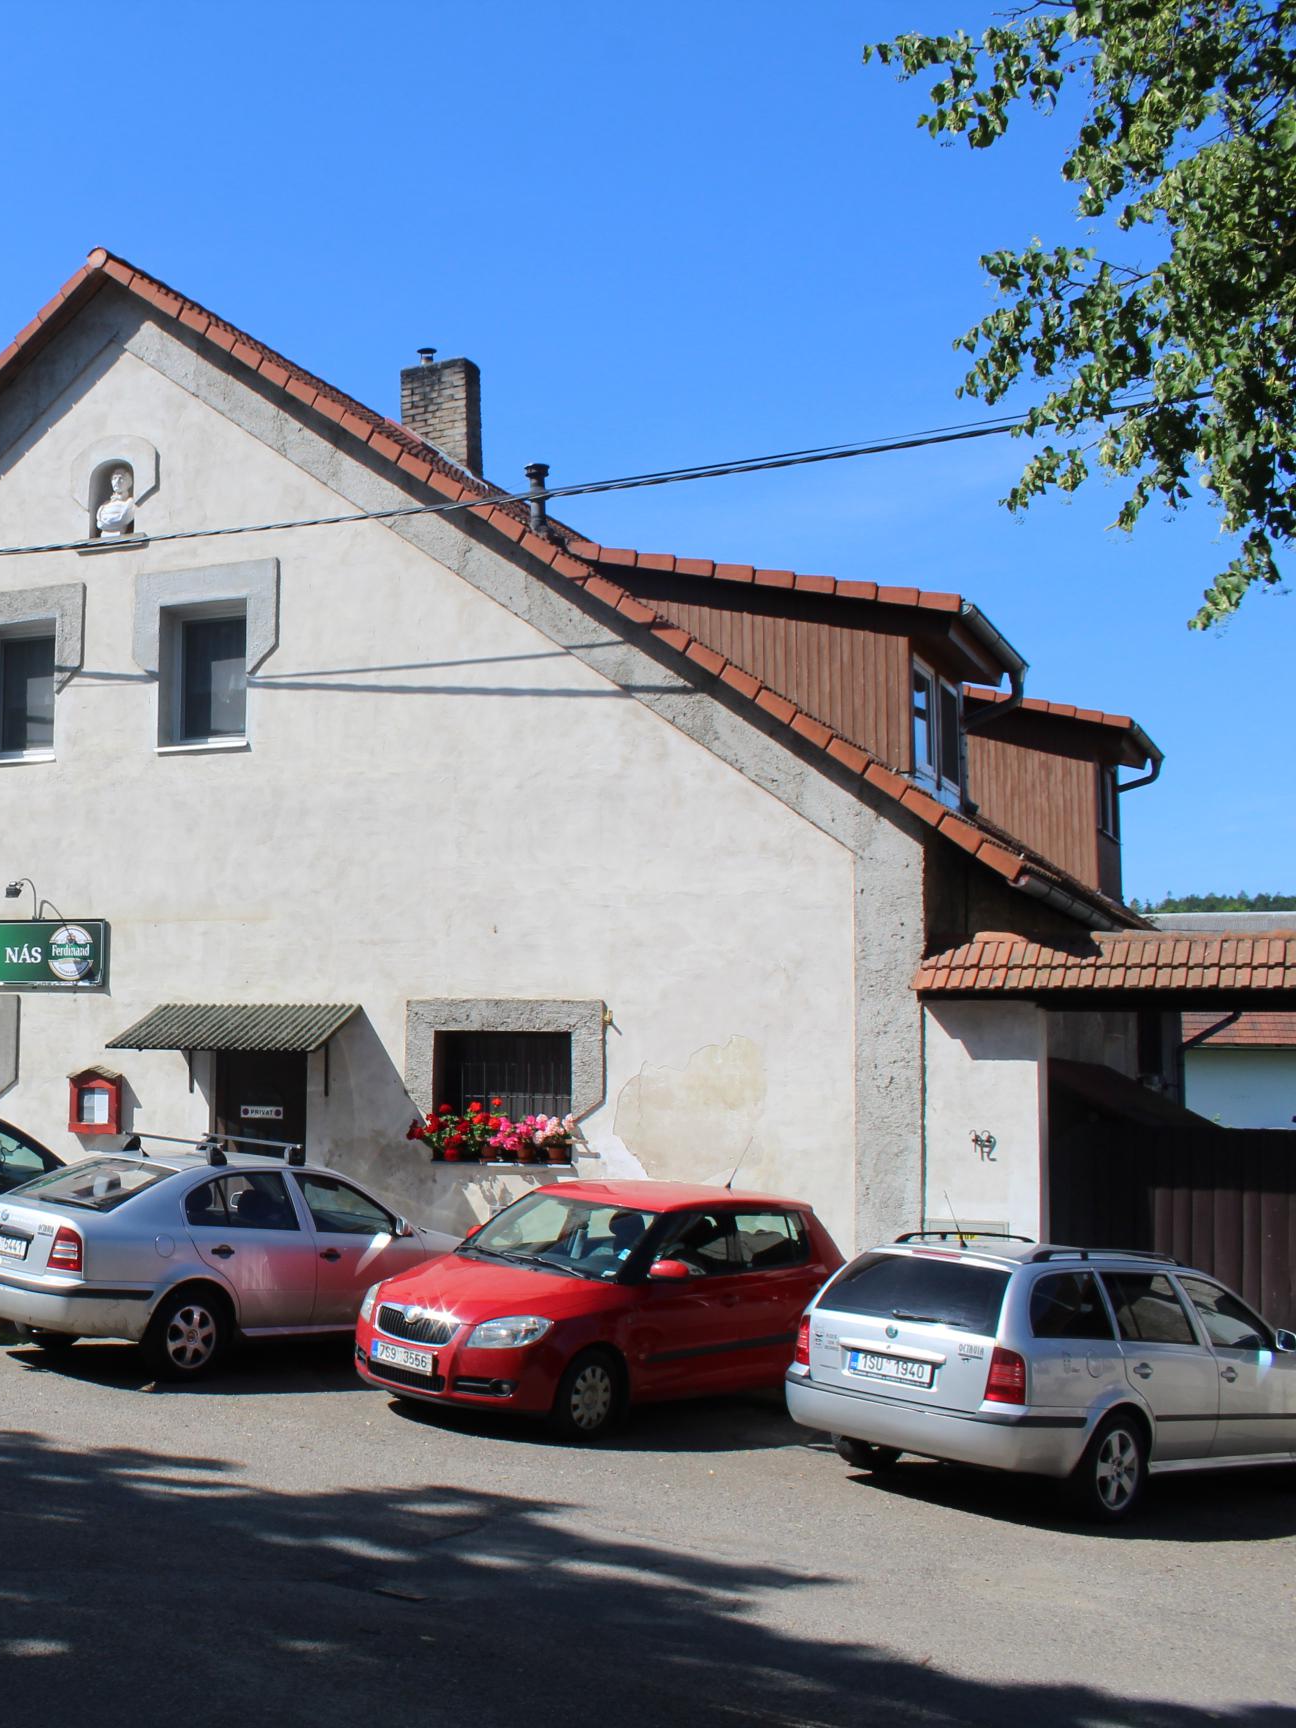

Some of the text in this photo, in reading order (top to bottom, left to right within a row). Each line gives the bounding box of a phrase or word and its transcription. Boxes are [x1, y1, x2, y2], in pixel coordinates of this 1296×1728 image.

[5, 943, 42, 964] NÁS
[51, 943, 90, 957] Ferdinand
[379, 1343, 427, 1369] 7S9 3556
[862, 1353, 883, 1372] 1SU
[894, 1359, 925, 1380] 1940
